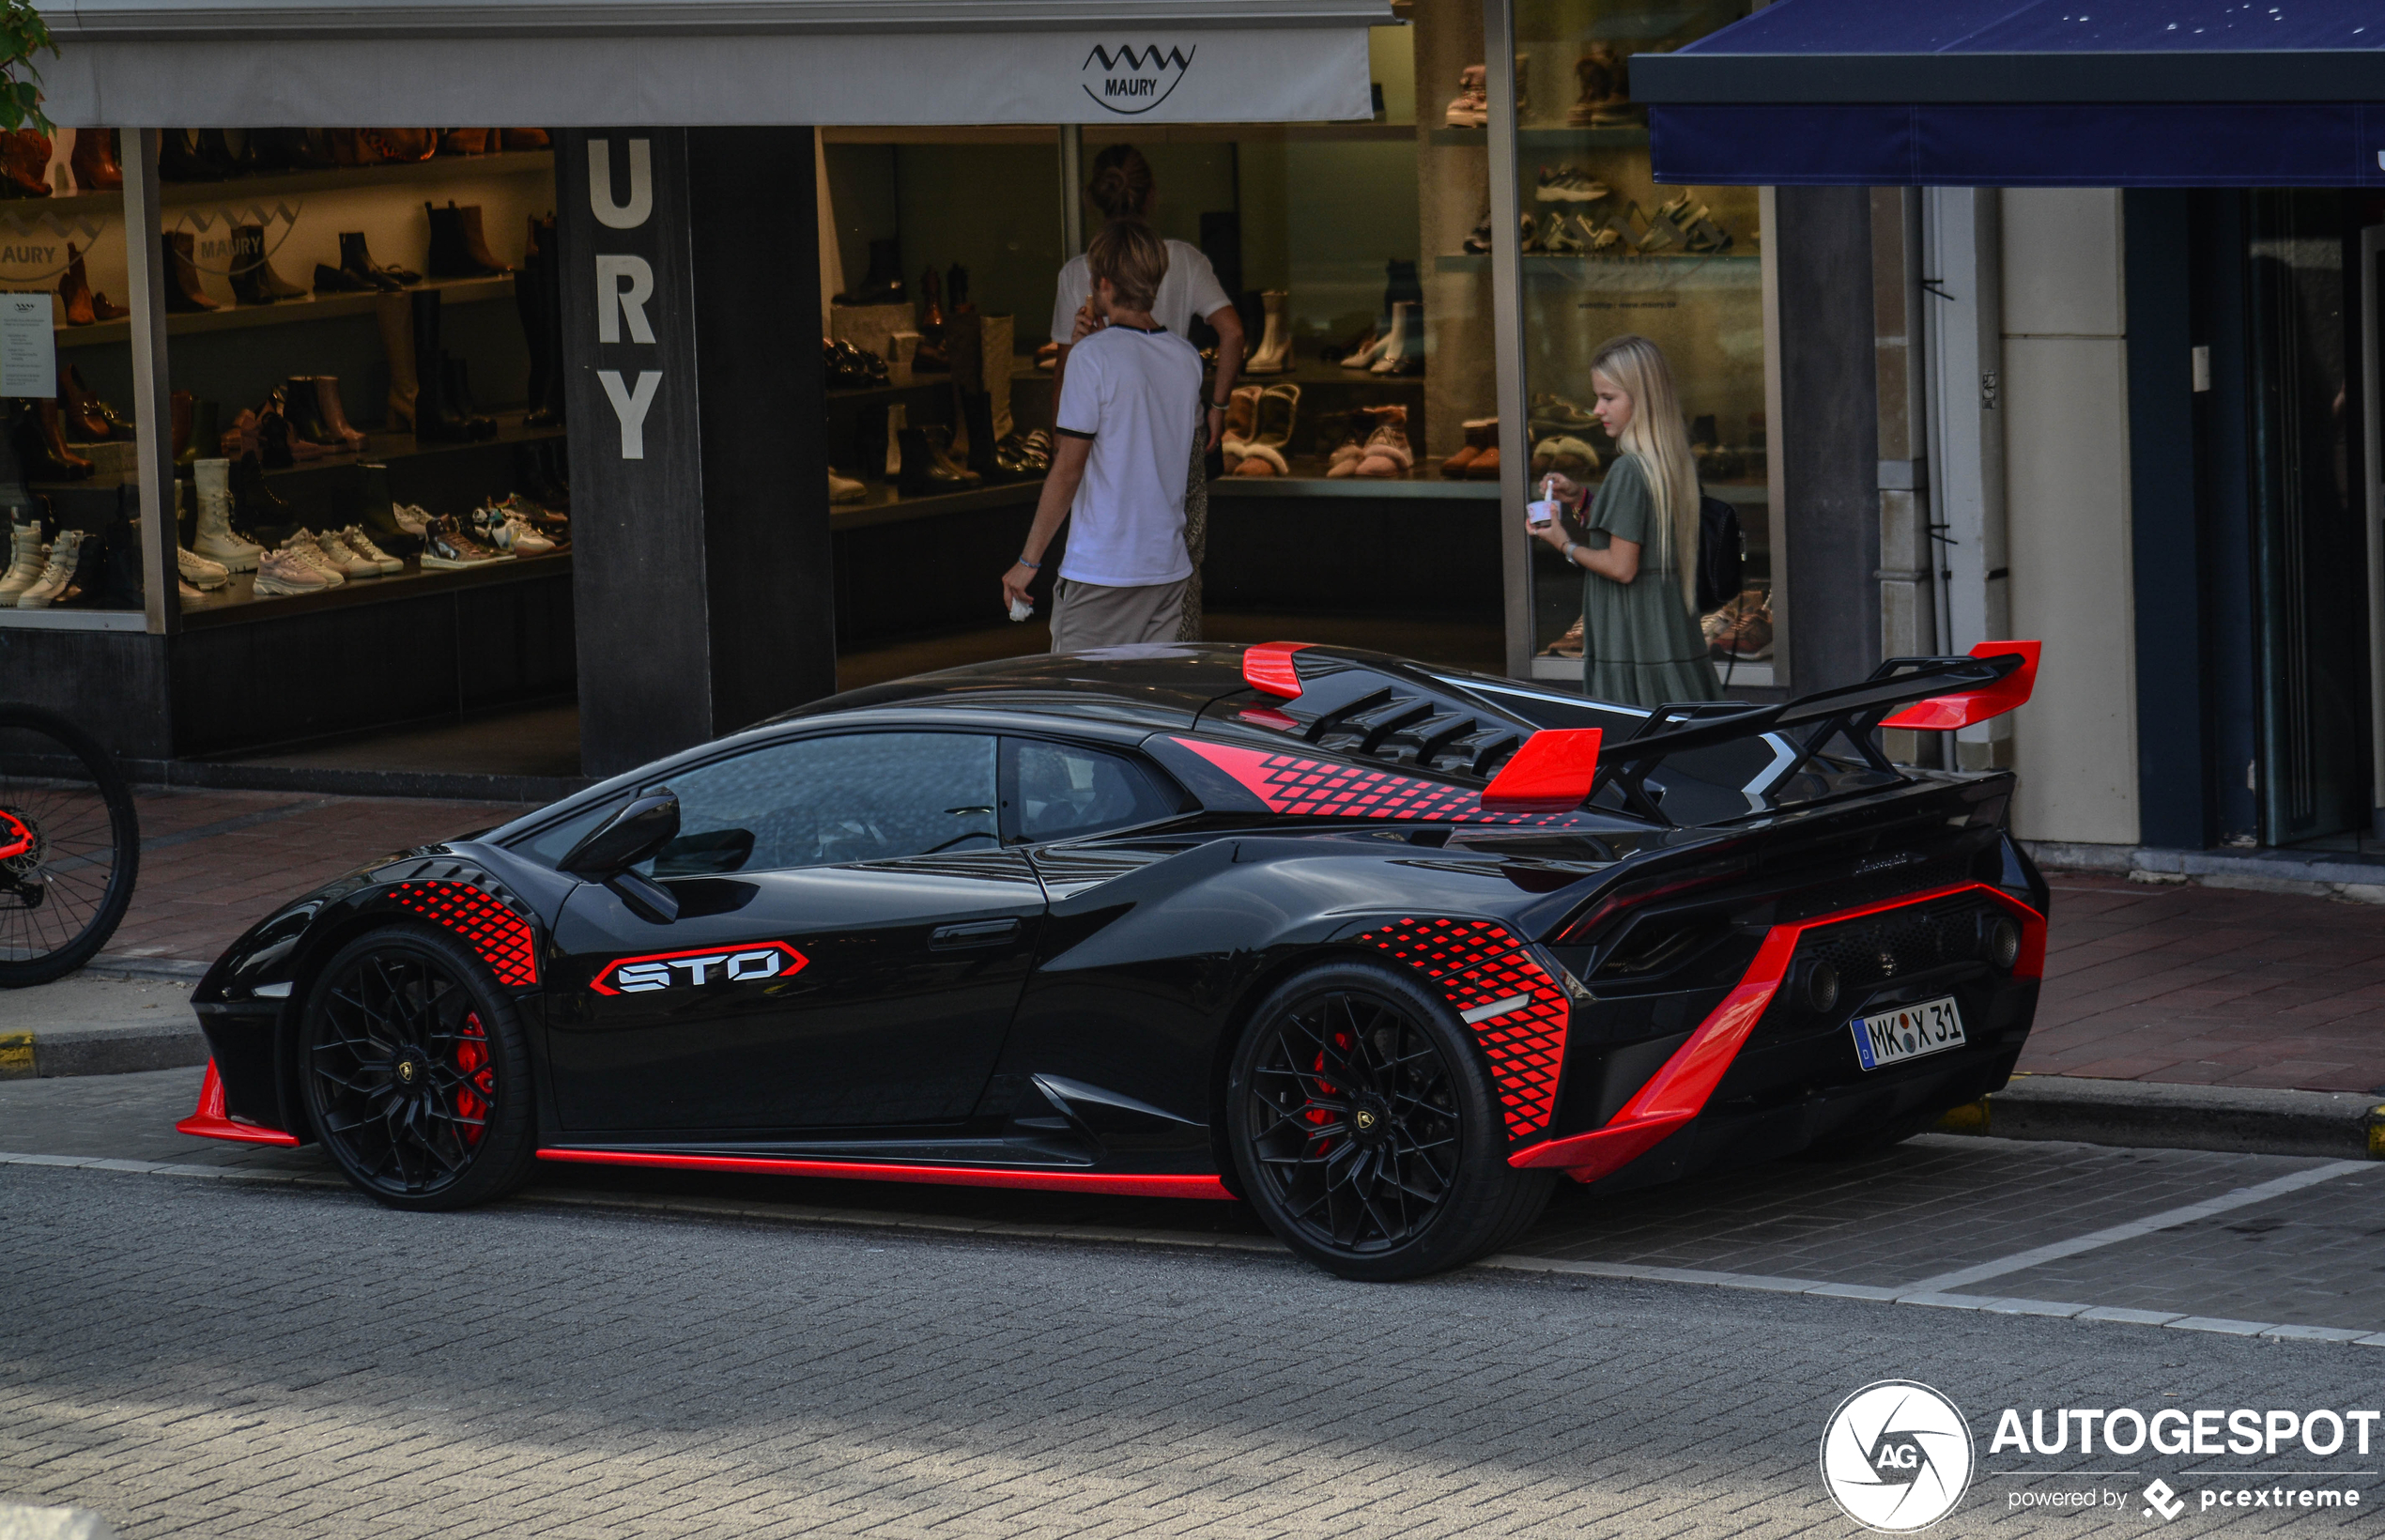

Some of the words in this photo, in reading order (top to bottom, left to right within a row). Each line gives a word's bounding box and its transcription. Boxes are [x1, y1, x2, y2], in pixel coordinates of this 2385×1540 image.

[1105, 78, 1158, 98] MAURY
[201, 236, 262, 259] MAURY
[618, 950, 780, 993] STO
[1862, 1049, 1870, 1060] D
[1868, 1017, 1903, 1059] MK
[1911, 1010, 1931, 1048] X
[1930, 1003, 1962, 1042] 31
